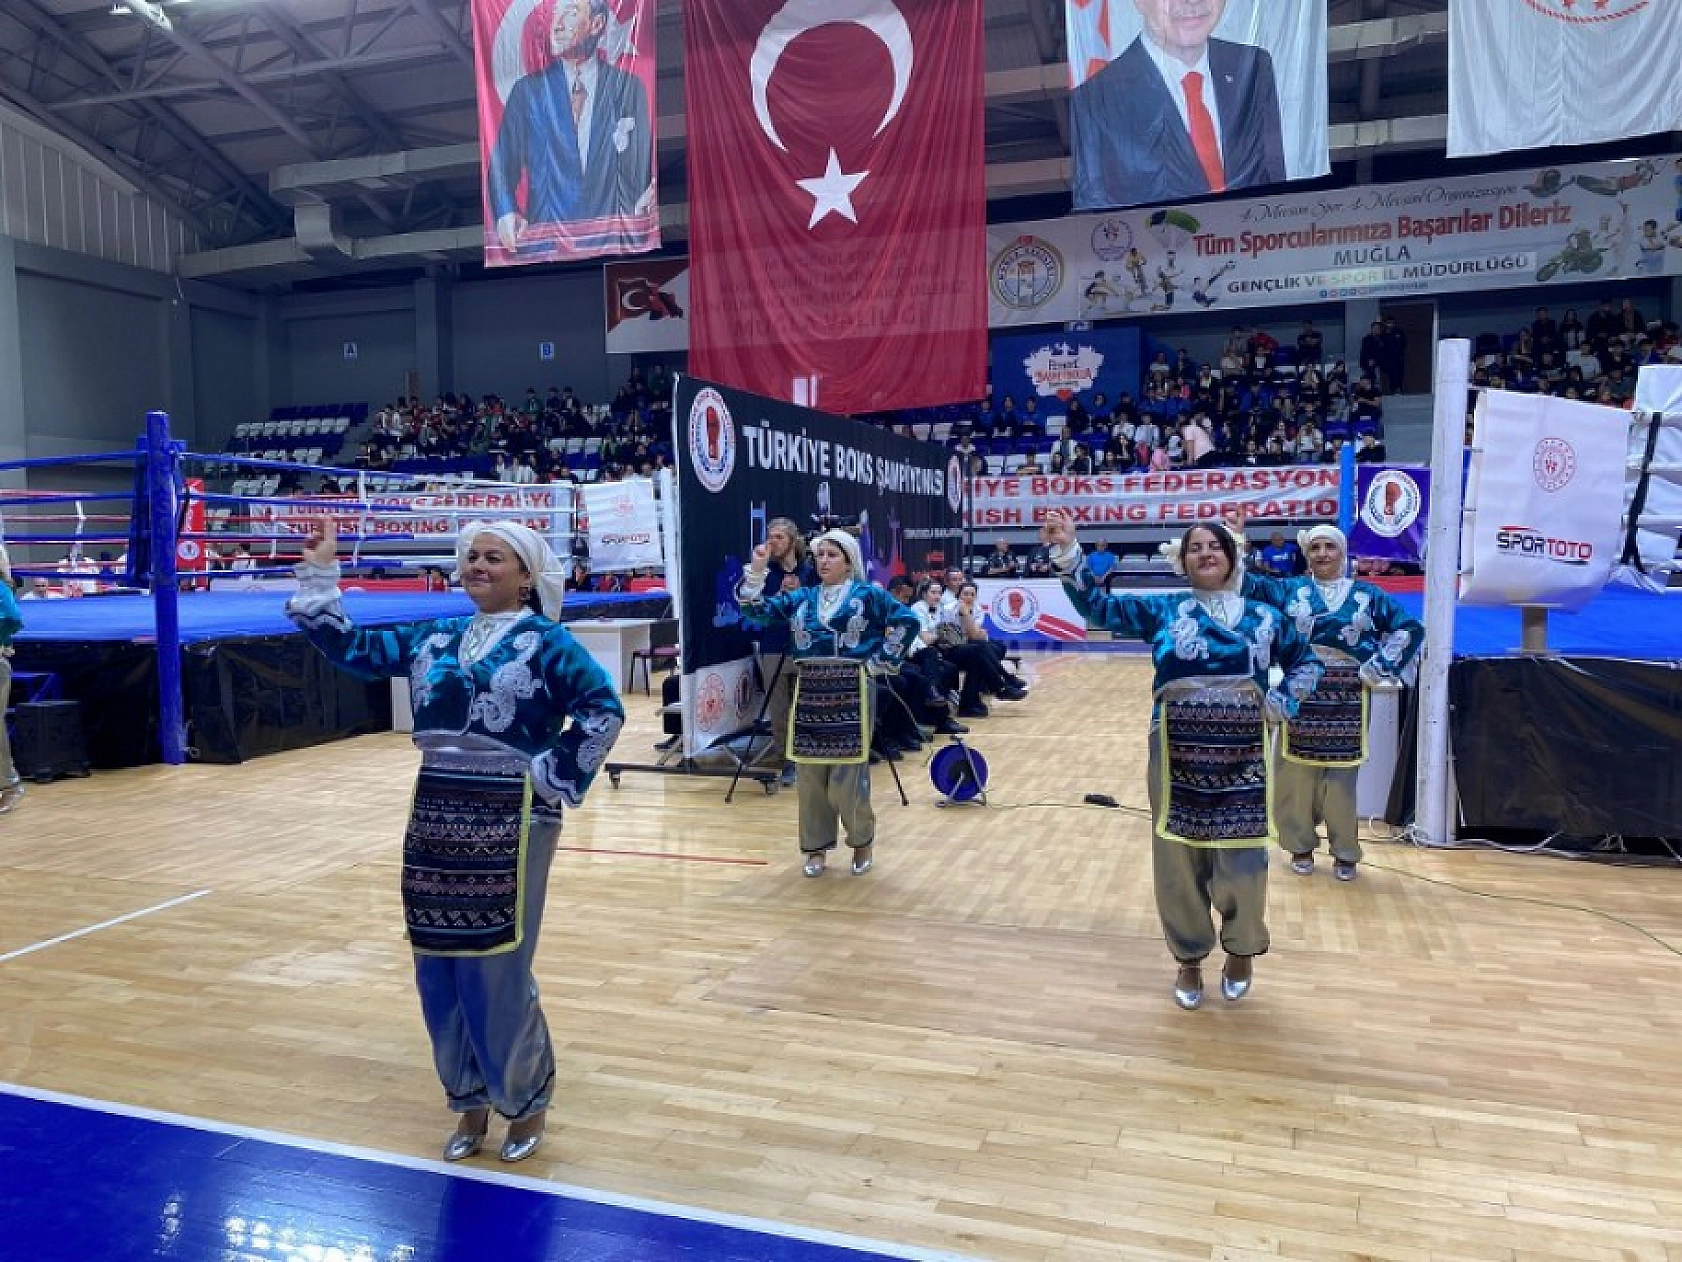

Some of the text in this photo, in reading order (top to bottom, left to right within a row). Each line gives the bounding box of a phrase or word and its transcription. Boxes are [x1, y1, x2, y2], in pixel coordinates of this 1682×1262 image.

[1193, 200, 1572, 259] Tüm Sporcularımıza Başarılar Dileriz
[1333, 244, 1411, 266] MUĞLA
[1227, 276, 1300, 293] GENÇLİK
[1304, 273, 1327, 289] VE
[1329, 269, 1379, 285] SPOR
[1403, 253, 1528, 279] MÜDÜRLÜĞÜ
[741, 419, 831, 477] TÜRKİYE
[833, 443, 873, 485] BOKS
[1031, 475, 1114, 496] BOKS
[1158, 498, 1339, 520] FEDERATIO
[374, 518, 450, 534] BOXING
[1496, 530, 1593, 559] SPORTOTO
